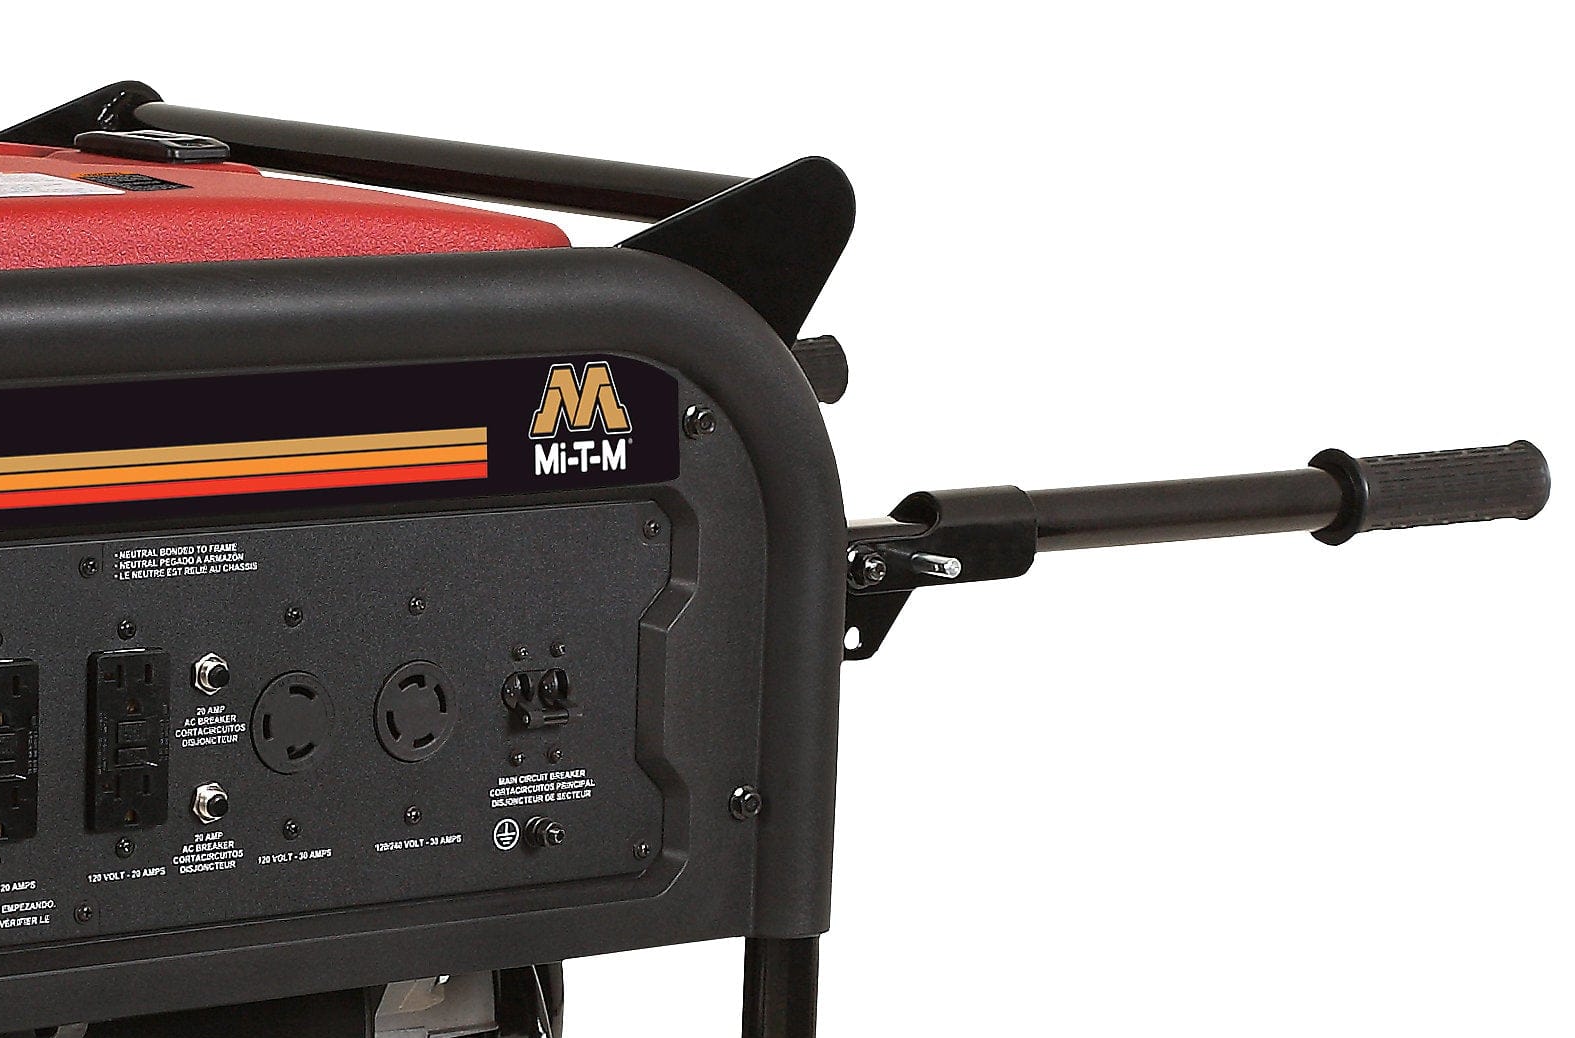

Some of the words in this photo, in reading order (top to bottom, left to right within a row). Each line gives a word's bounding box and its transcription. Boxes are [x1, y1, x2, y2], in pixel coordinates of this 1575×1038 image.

[534, 438, 627, 476] Mi-T-M
[120, 549, 158, 559] NEUTRAL
[160, 547, 194, 556] BONDED
[197, 545, 207, 553] TO
[209, 543, 237, 552] FRAME
[120, 560, 158, 569] NEUTRAL
[160, 557, 194, 566] PEGADO
[132, 569, 165, 578] NEUTRE
[209, 565, 221, 573] AU
[208, 706, 225, 714] AMP
[185, 718, 195, 726] AC
[198, 715, 236, 725] BREAKER
[176, 724, 245, 737] CORTACIRCUITOS
[519, 774, 548, 783] CIRCUIT
[550, 770, 585, 780] BREAKER
[490, 783, 554, 797] CORTACIRCUITOS
[557, 790, 591, 800] SECTEUR
[205, 832, 223, 841] AMP
[404, 839, 424, 848] VOLT
[440, 835, 461, 844] AMPS
[183, 845, 194, 853] AC
[196, 841, 234, 852] BREAKER
[173, 850, 243, 864] CORTACIRCUITOS
[259, 856, 270, 864] 120
[272, 853, 293, 862] VOLT
[309, 849, 331, 858] AMPS
[88, 874, 101, 882] 120
[103, 872, 125, 881] VOLT
[143, 867, 165, 876] AMPS
[12, 881, 35, 891] AMPS
